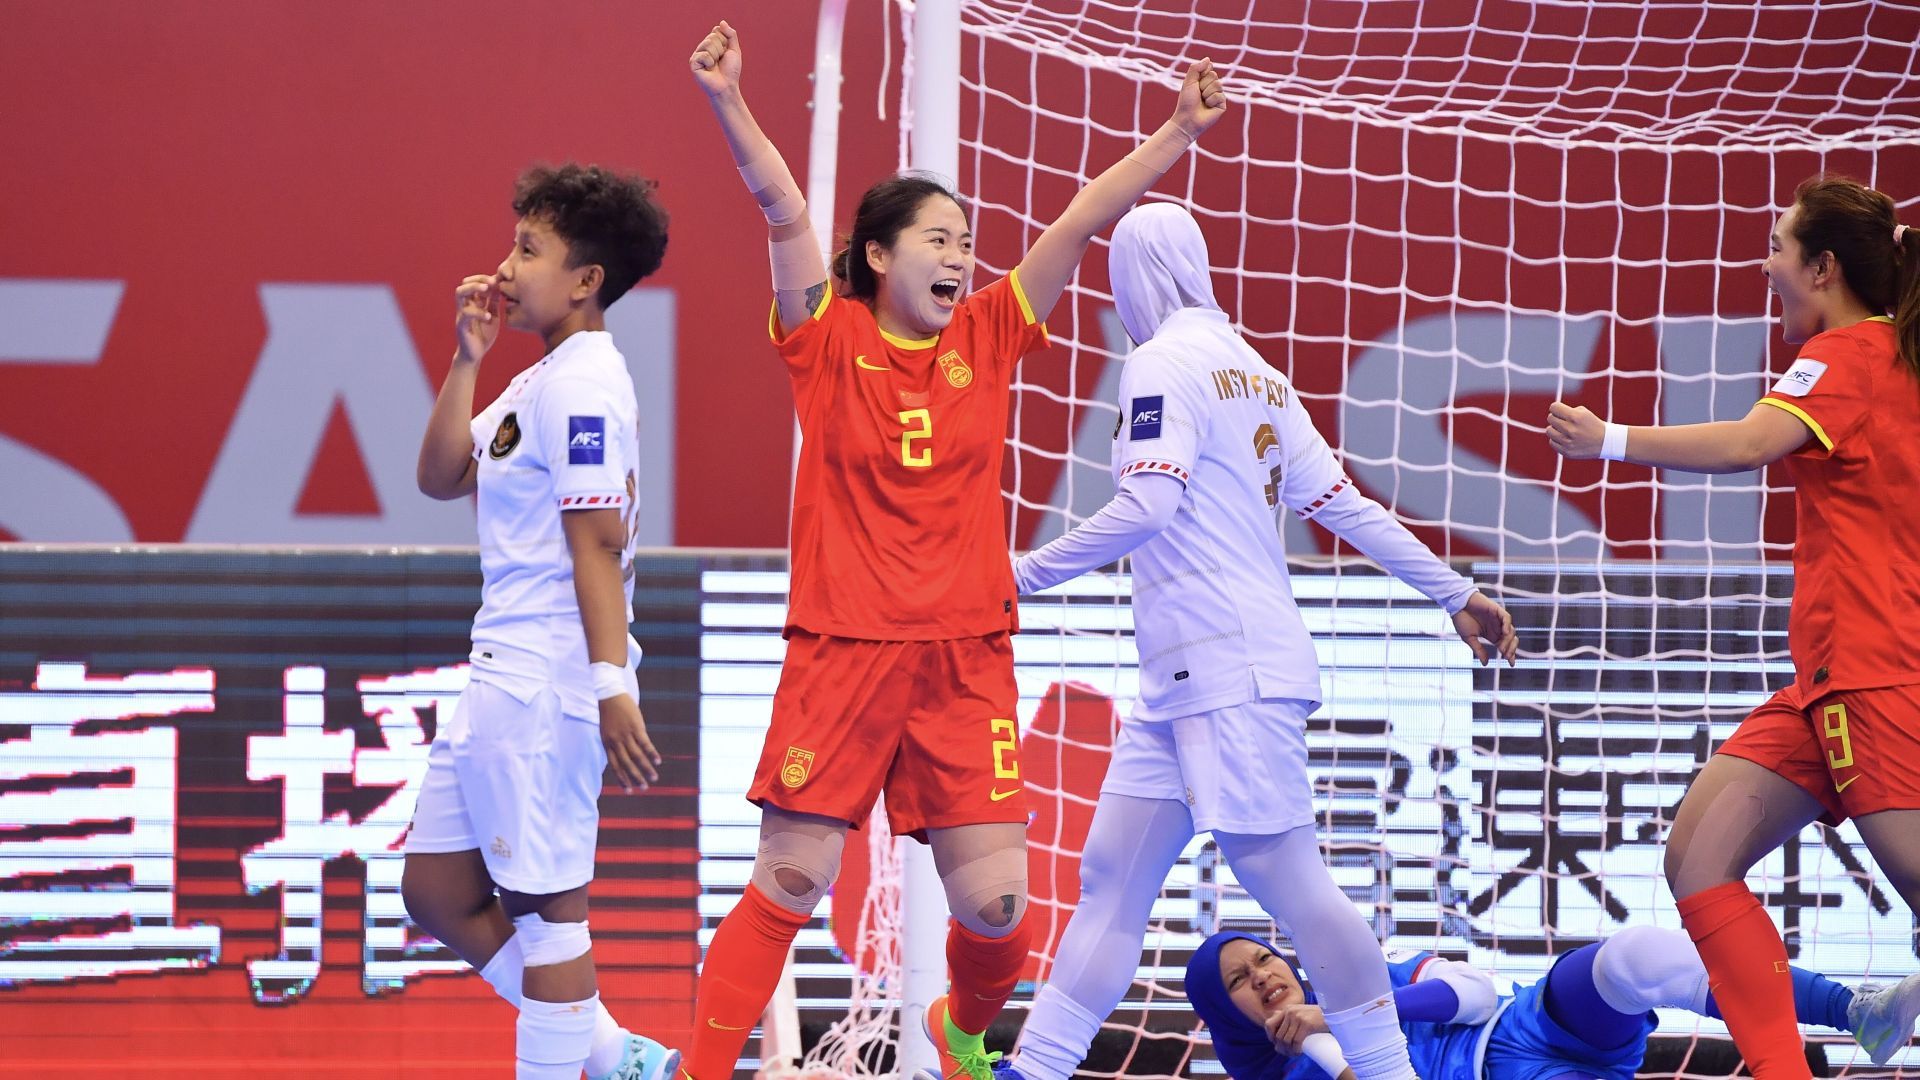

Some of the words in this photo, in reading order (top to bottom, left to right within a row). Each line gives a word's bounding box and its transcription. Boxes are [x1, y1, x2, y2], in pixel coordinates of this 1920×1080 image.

[1133, 409, 1161, 424] AFC
[570, 431, 601, 446] AFC
[898, 408, 932, 467] 2
[990, 718, 1019, 780] 2
[1823, 703, 1854, 770] 9
[789, 749, 812, 762] CFA
